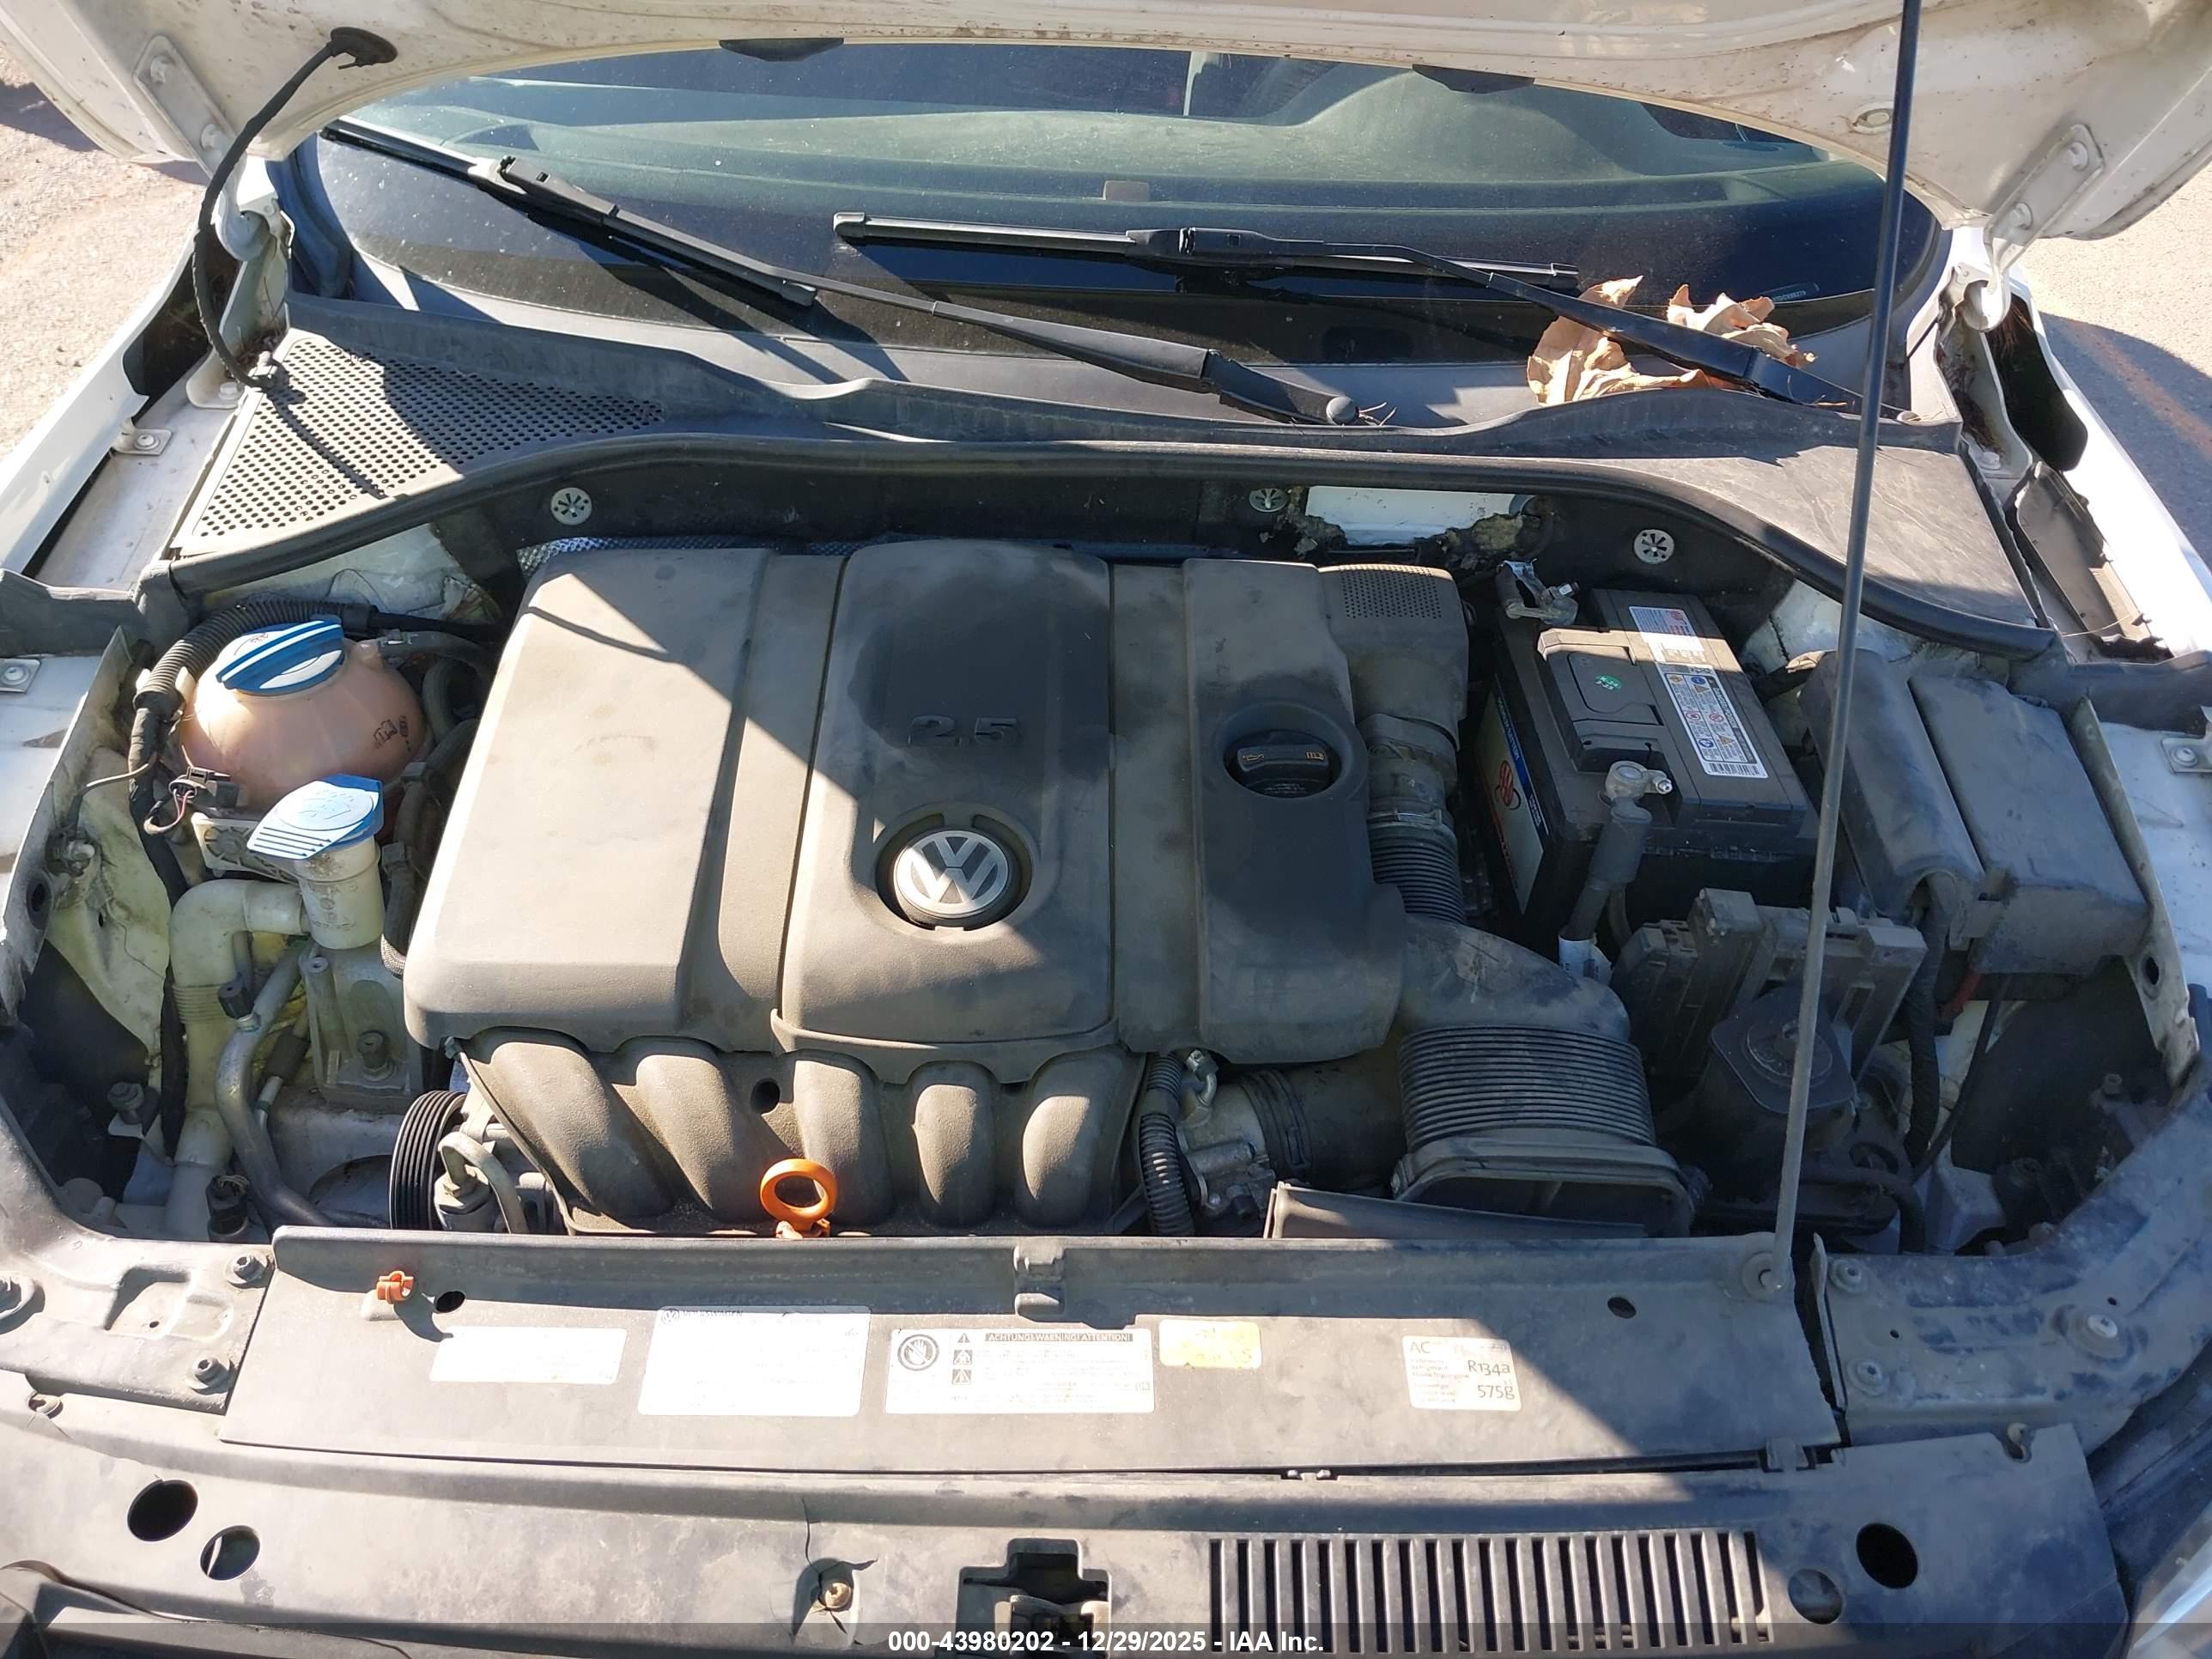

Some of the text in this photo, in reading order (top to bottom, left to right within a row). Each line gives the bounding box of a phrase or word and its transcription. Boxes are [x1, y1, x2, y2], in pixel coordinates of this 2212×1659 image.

[906, 714, 1019, 745] 2.5
[988, 1333, 1035, 1341] ACHTUNG!
[1036, 1333, 1081, 1341] WARNING!
[1409, 1340, 1431, 1354] AC
[1468, 1359, 1511, 1376] R134a
[1477, 1384, 1516, 1400] 575g
